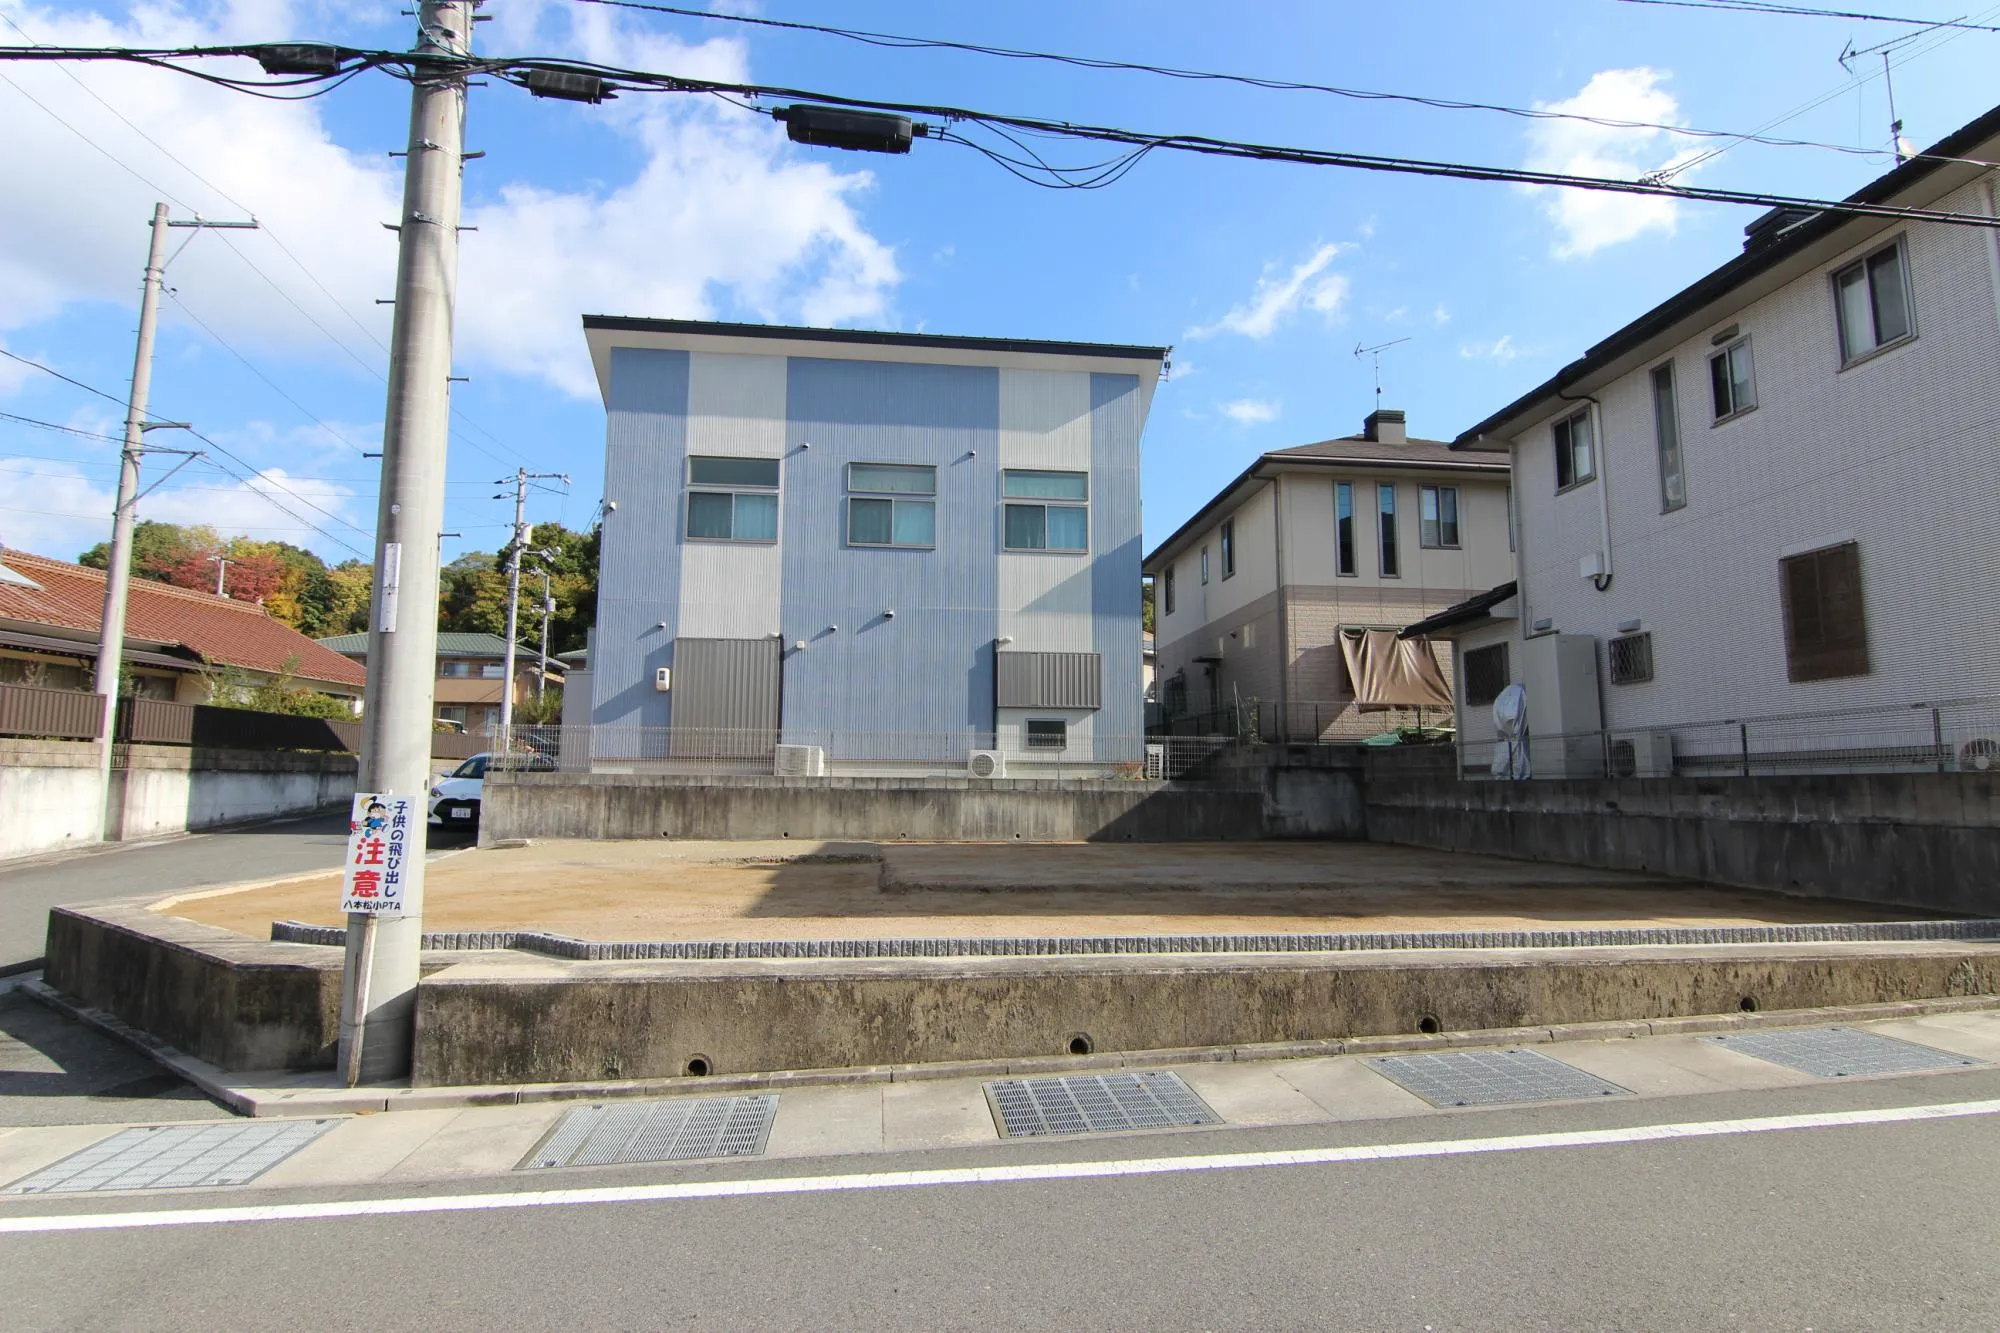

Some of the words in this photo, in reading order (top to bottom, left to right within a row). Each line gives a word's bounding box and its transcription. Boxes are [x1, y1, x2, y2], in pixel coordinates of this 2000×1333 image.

[351, 837, 386, 898] 注意
[384, 801, 408, 897] 子供の飛び出し
[343, 900, 401, 910] 八本松小PTA
